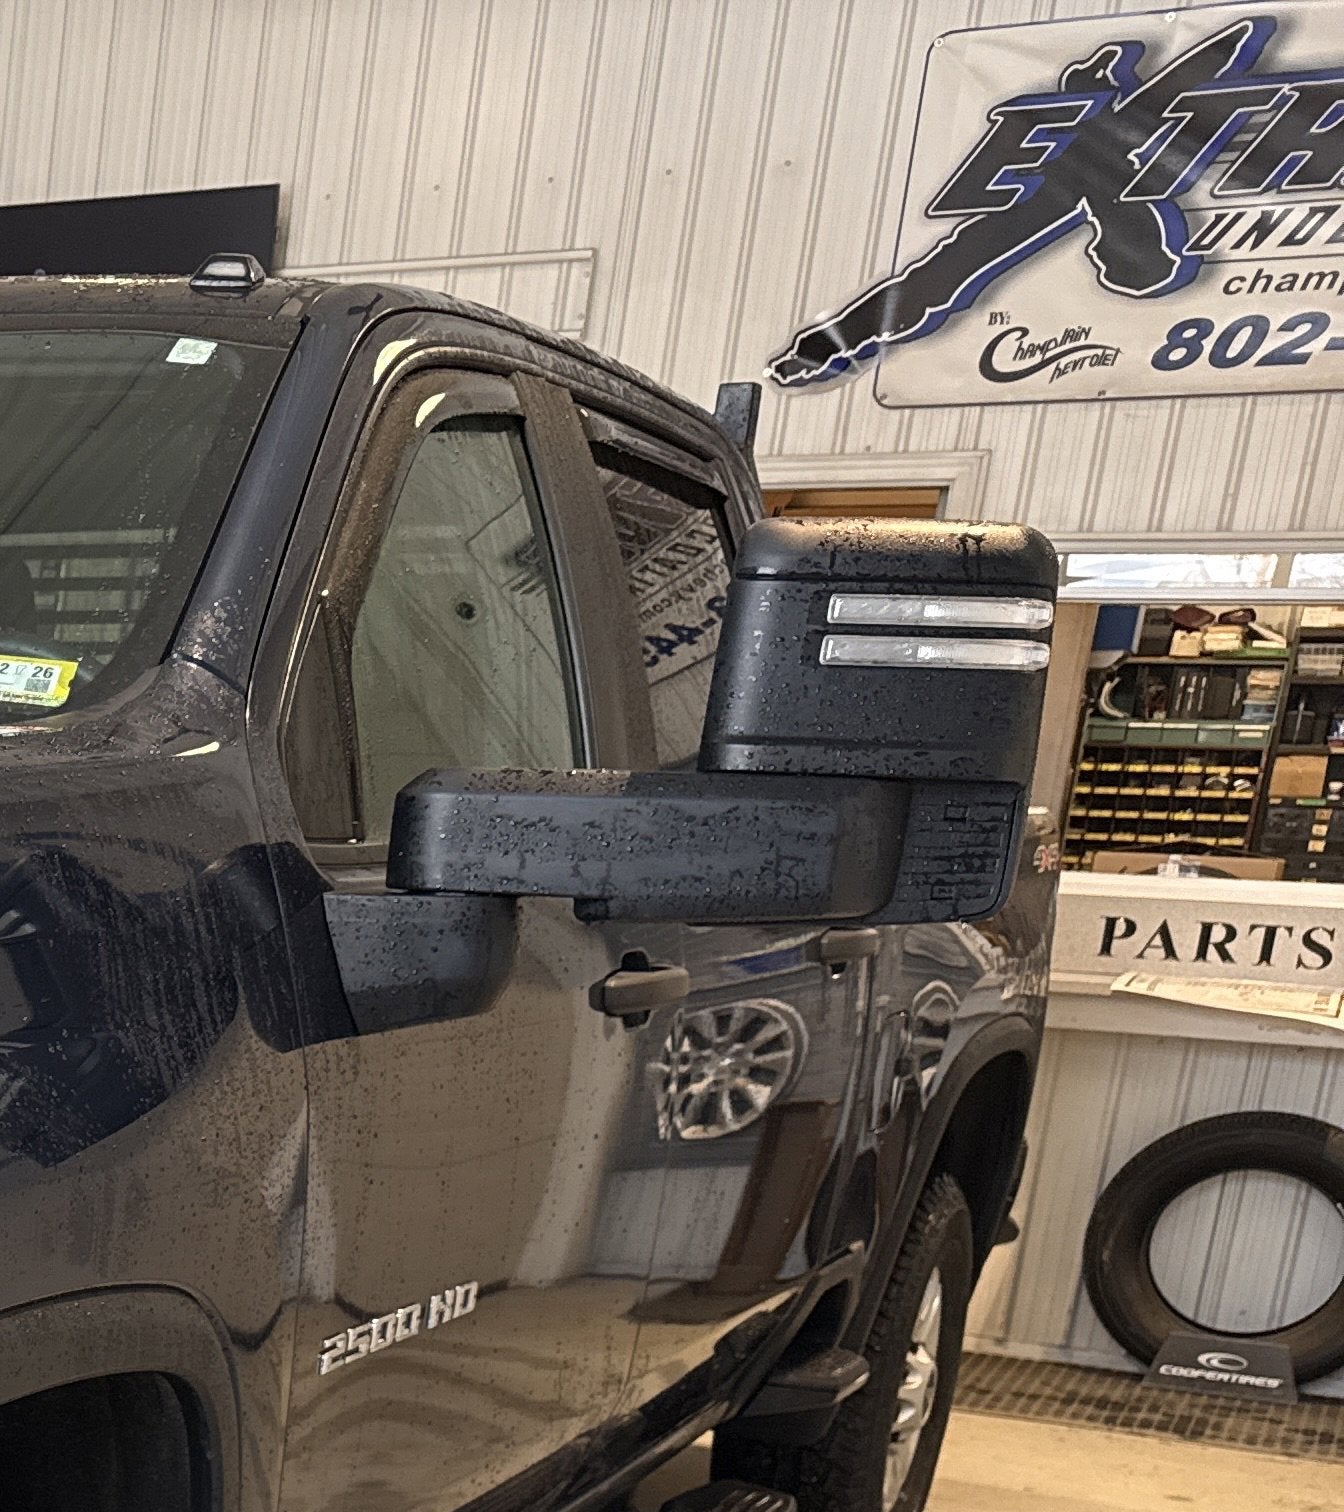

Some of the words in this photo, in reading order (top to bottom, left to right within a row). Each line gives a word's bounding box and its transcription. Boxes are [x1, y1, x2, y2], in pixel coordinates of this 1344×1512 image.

[1183, 204, 1344, 255] UND
[1222, 268, 1344, 297] cham
[988, 311, 1011, 326] BY:
[30, 665, 55, 680] 26
[1097, 914, 1336, 972] PARTS
[318, 1302, 422, 1376] 2500
[426, 1280, 479, 1330] HD
